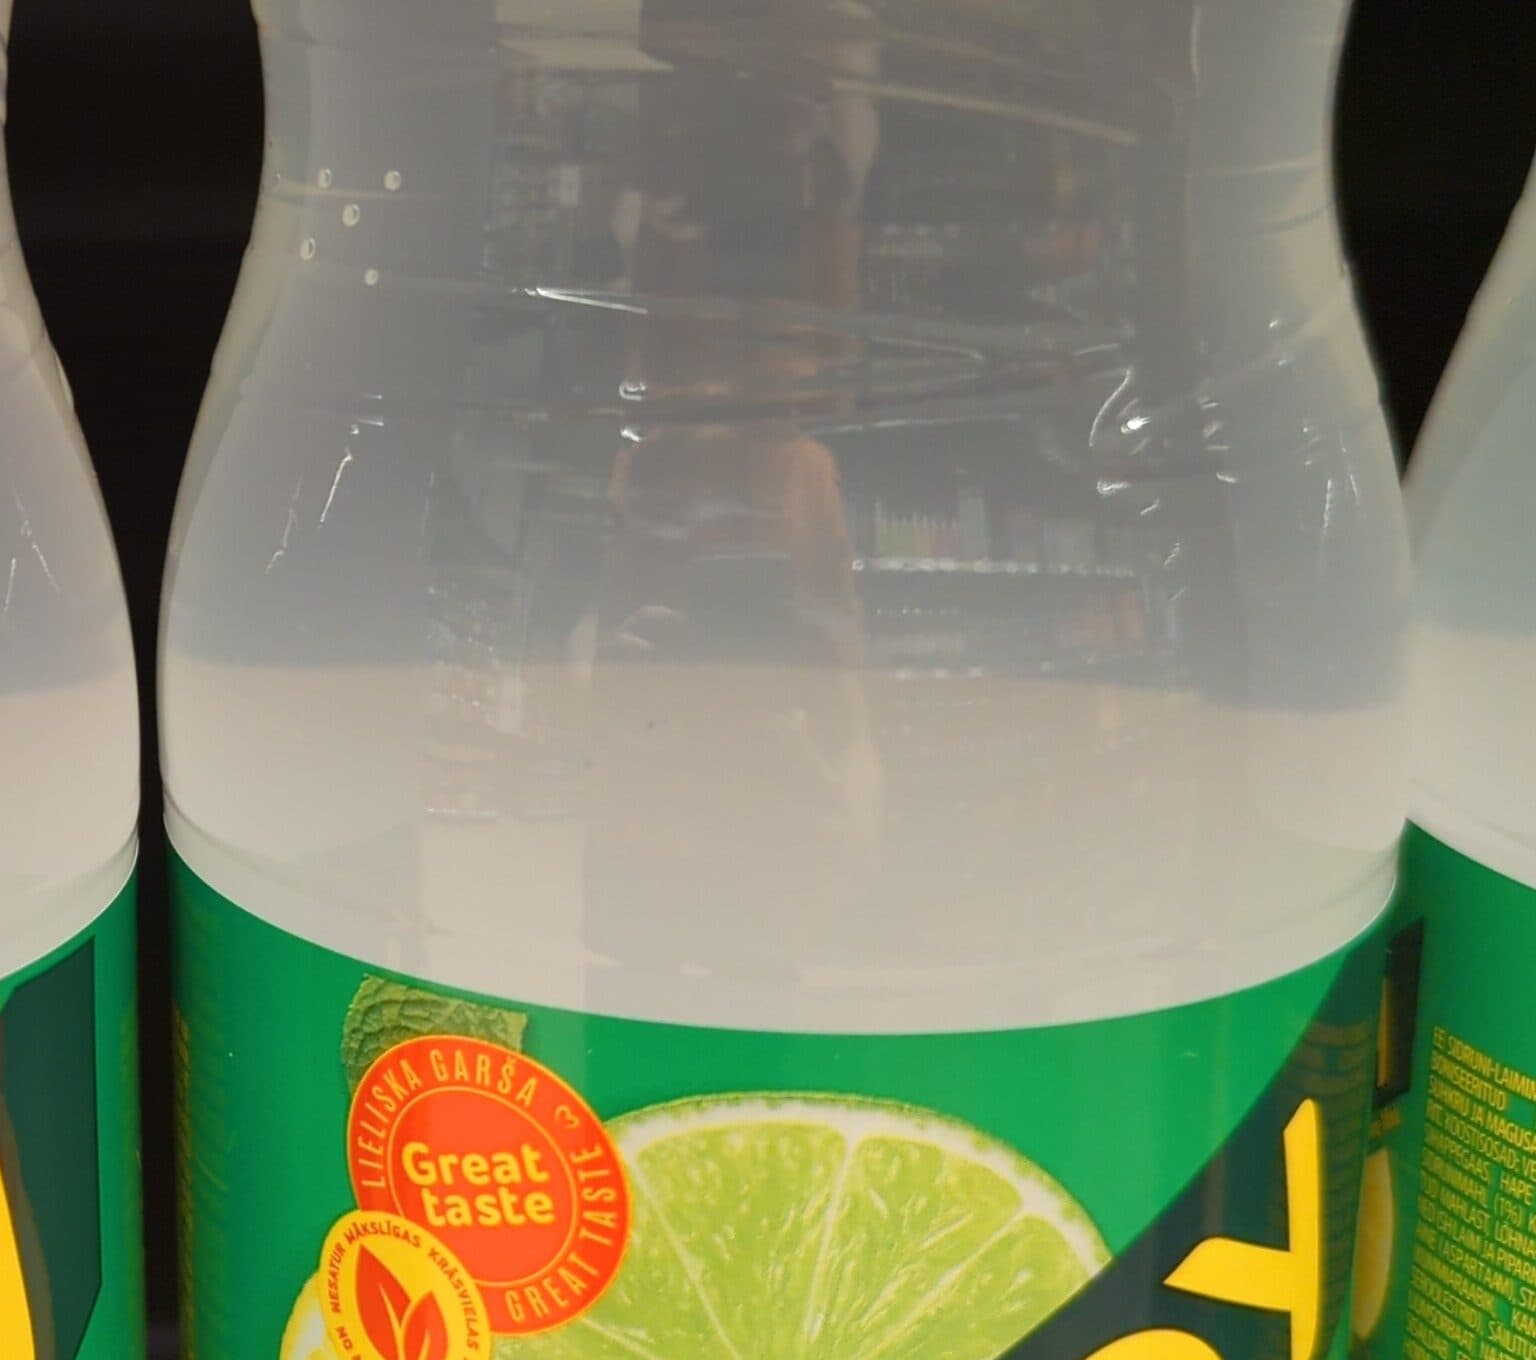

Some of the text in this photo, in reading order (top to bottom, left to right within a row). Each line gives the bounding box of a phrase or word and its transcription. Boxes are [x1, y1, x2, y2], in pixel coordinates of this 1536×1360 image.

[356, 1048, 539, 1189] LIELISKA GARŠA
[402, 1140, 550, 1185] Great
[420, 1186, 556, 1228] taste
[503, 1142, 617, 1324] GREAT TASTE
[426, 1246, 481, 1351] KRĀSVIELAS
